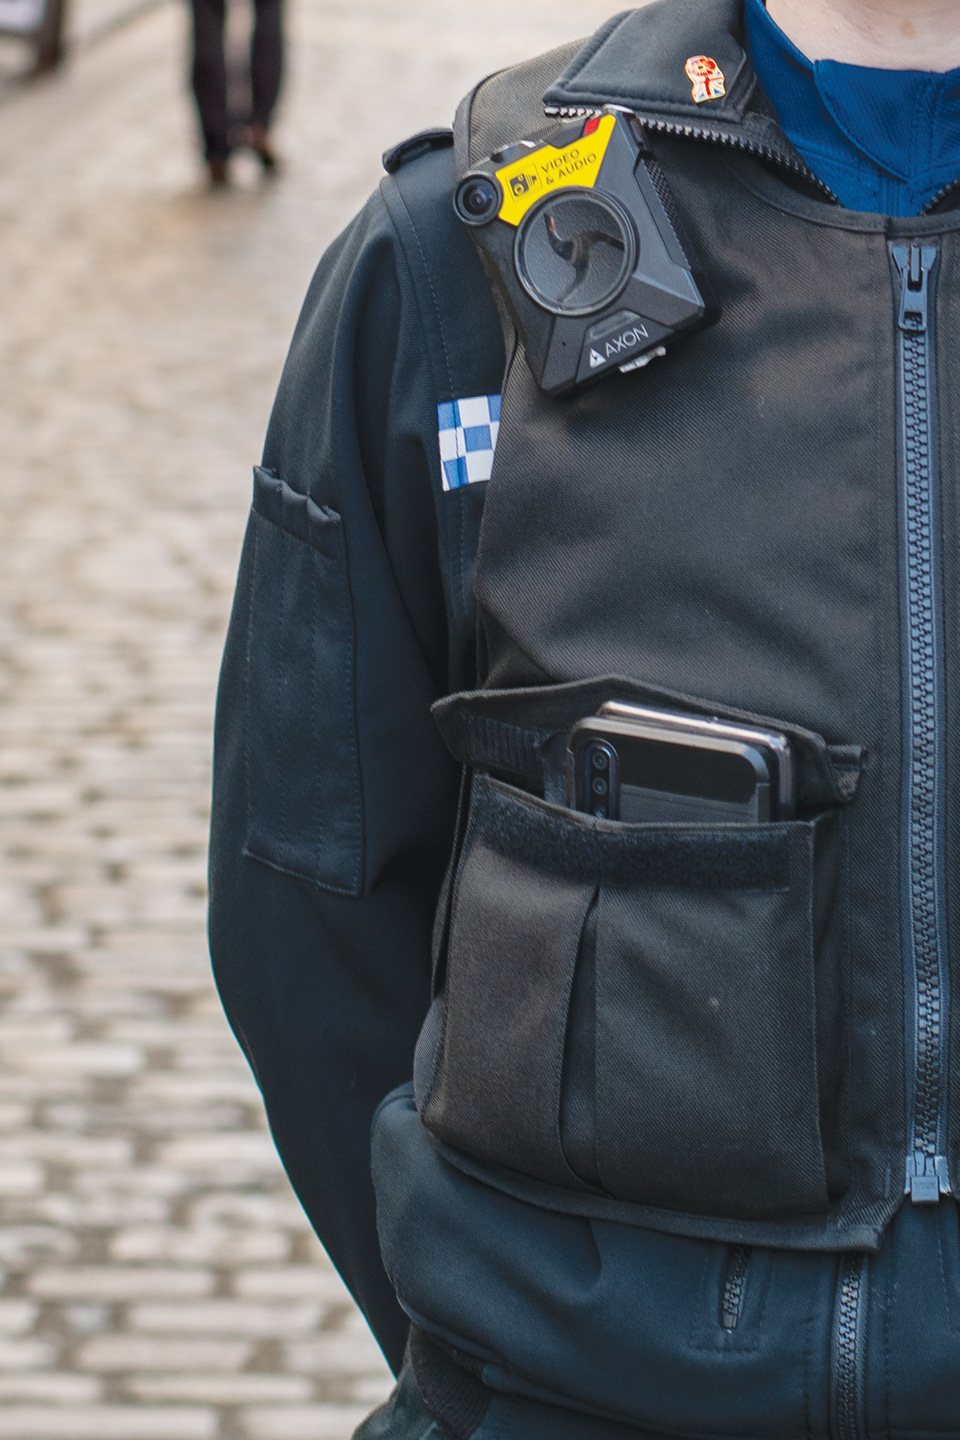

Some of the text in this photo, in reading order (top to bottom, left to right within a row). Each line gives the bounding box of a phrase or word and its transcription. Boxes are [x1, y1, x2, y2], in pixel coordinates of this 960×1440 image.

[541, 148, 580, 173] VIDEO
[546, 153, 597, 185] & AUDIO
[605, 323, 649, 358] AXON
